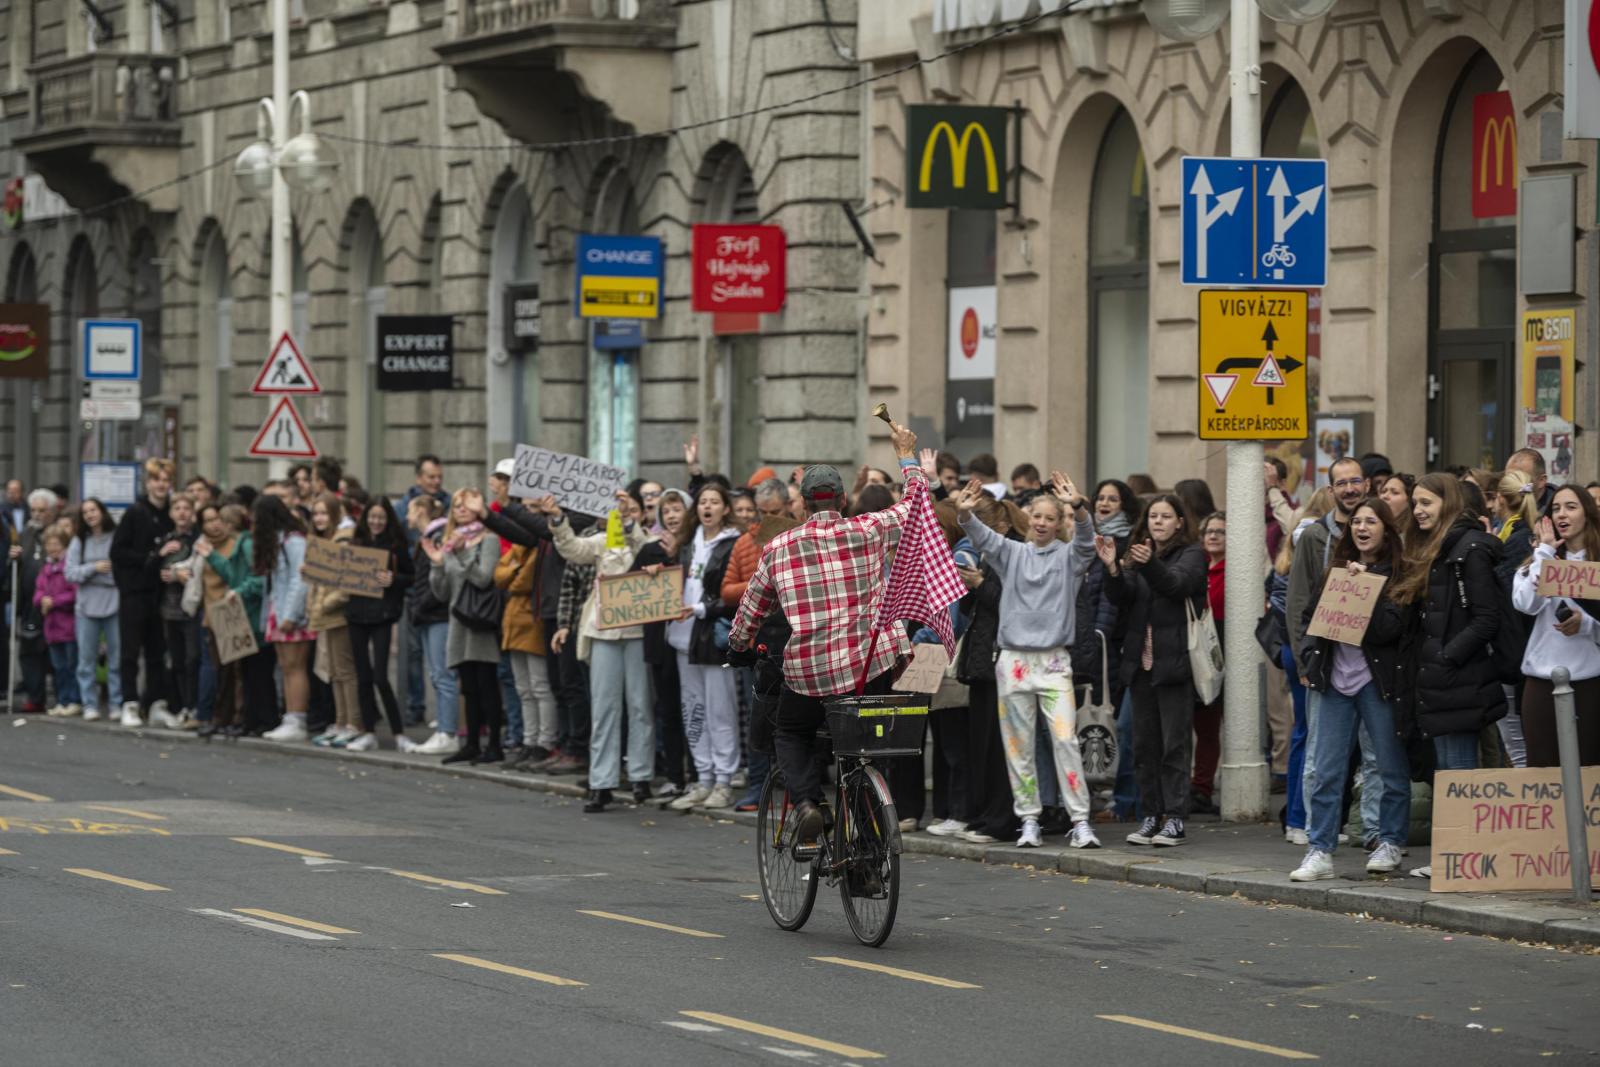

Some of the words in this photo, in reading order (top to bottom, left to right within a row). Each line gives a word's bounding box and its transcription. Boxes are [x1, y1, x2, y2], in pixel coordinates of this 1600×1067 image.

[586, 248, 653, 264] CHANGE
[711, 281, 765, 302] Szalon
[1220, 295, 1292, 316] VIGYÁZZ!
[384, 334, 448, 351] EXPERT
[382, 355, 449, 372] CHANGE
[1207, 414, 1300, 431] KERÉKPÁROSOK
[516, 450, 567, 473] NEM
[567, 457, 626, 485] AKAROK
[1545, 564, 1600, 588] DUDÁL
[1446, 782, 1515, 799] AKKOR
[1473, 799, 1555, 834] PINTÉR
[1439, 852, 1497, 880] TECCIK
